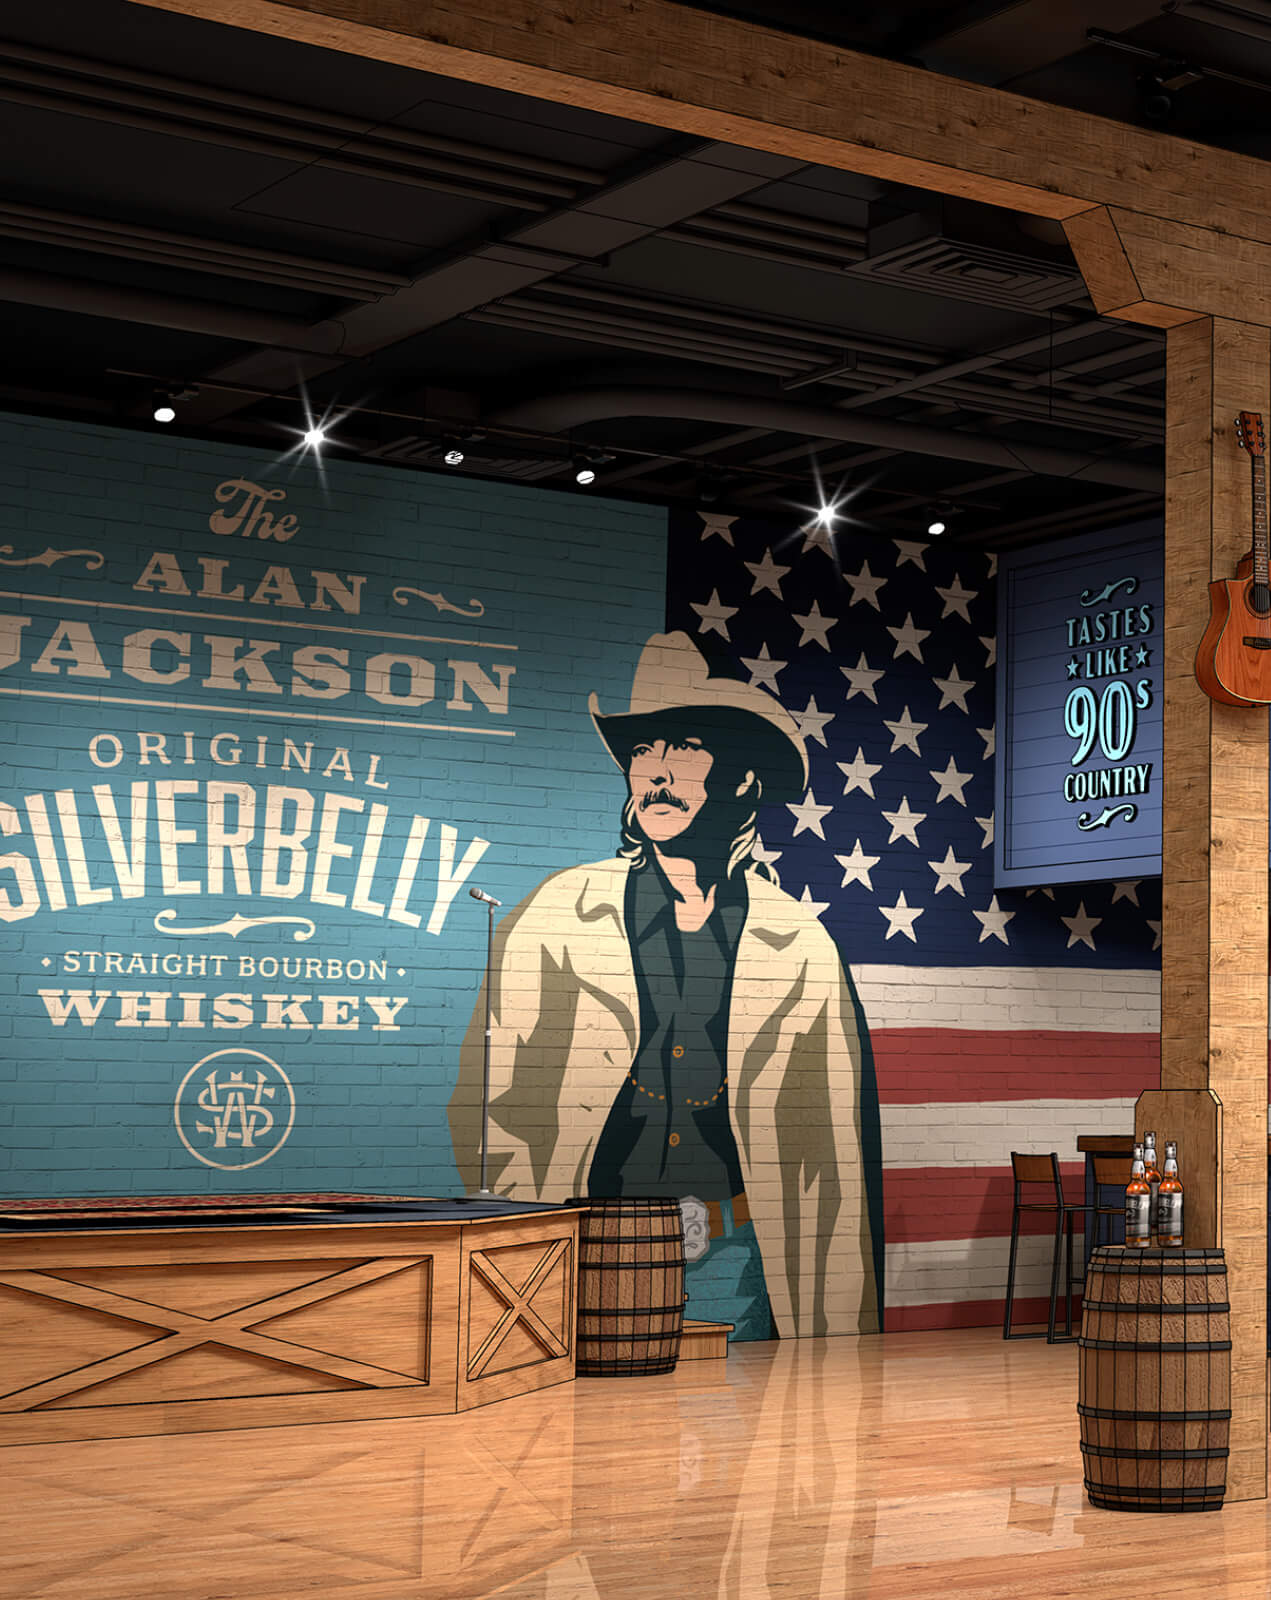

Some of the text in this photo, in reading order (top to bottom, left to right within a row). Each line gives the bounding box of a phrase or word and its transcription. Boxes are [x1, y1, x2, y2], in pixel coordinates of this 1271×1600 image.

[208, 476, 299, 542] The
[133, 552, 367, 615] ALAN
[1066, 604, 1152, 648] TASTES
[1085, 646, 1130, 679] LIKE
[89, 732, 390, 790] ORIGINAL
[1064, 764, 1150, 801] COUNTRY
[0, 780, 491, 936] SILVERBELLY
[63, 951, 389, 981] STRAIGHT BOURBON
[38, 989, 409, 1032] WHISKEY
